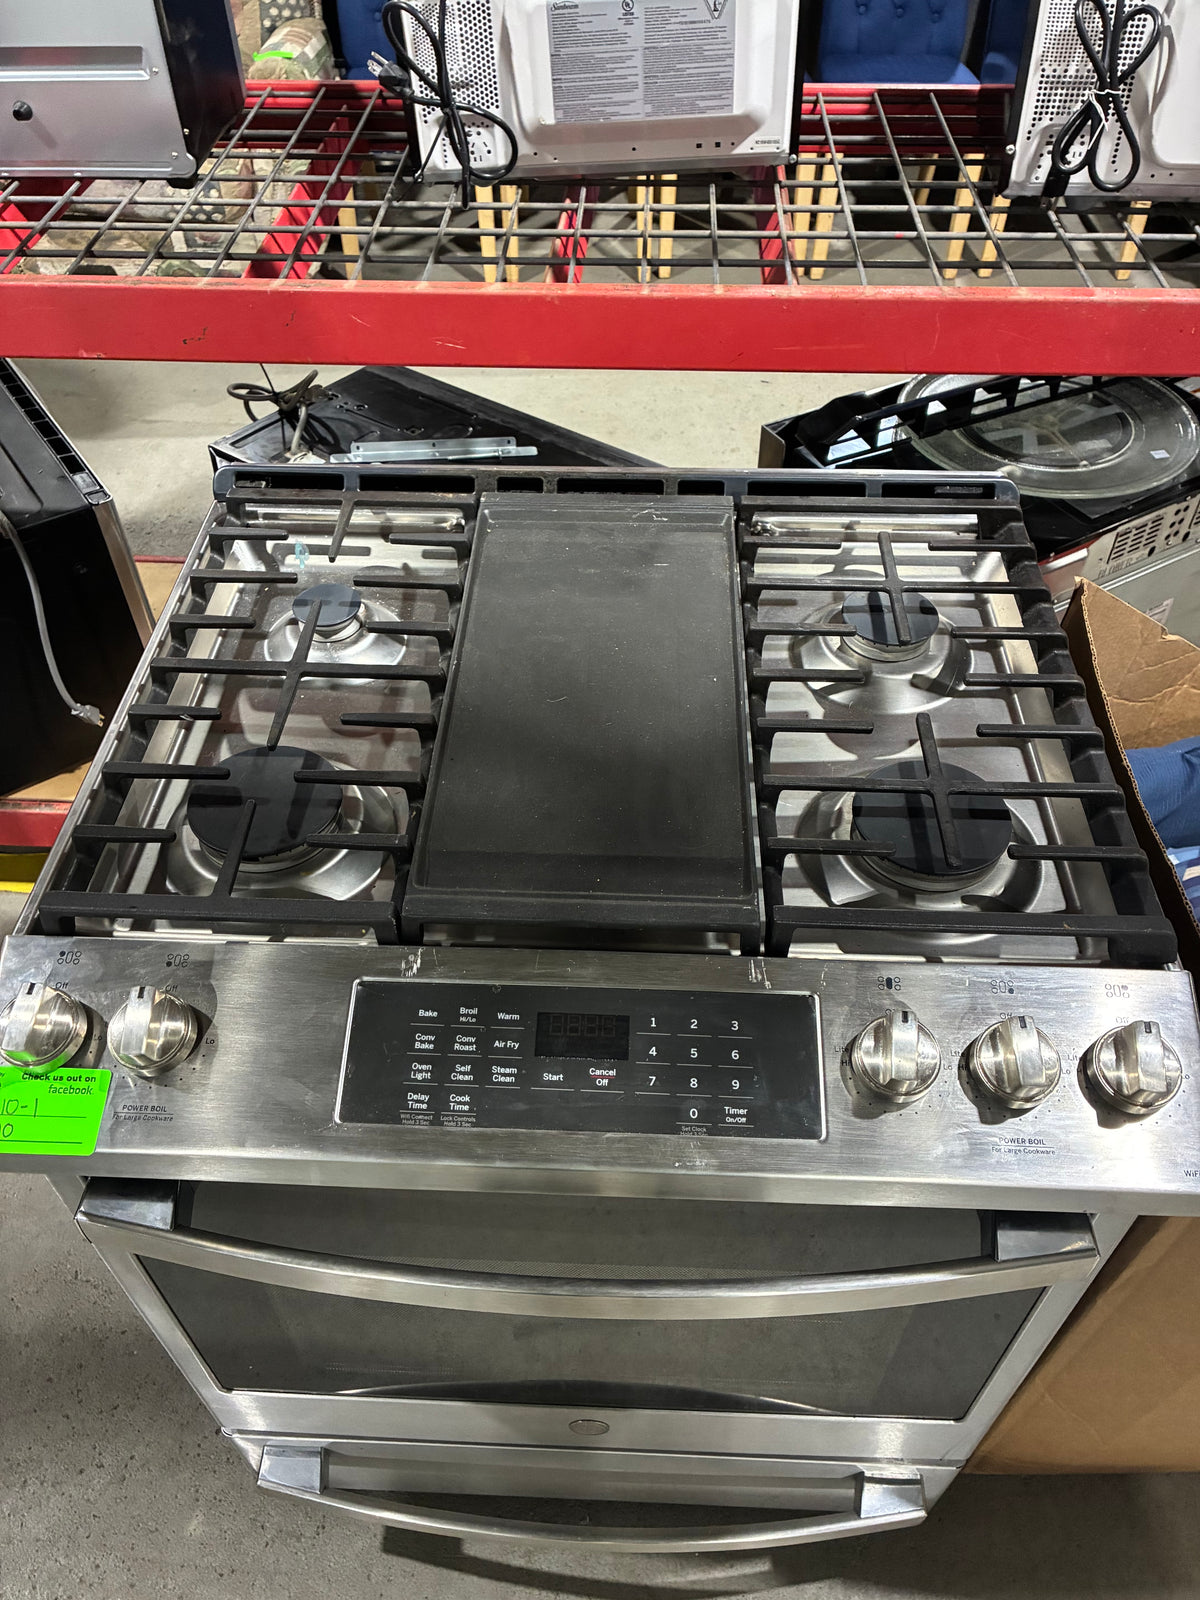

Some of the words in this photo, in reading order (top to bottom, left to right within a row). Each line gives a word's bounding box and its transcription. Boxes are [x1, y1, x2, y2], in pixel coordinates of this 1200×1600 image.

[551, 2, 579, 11] Sunbeam
[418, 1009, 438, 1018] Bake
[460, 1007, 478, 1015] Broil
[497, 1013, 520, 1021] Warm
[649, 1018, 657, 1028] 1
[690, 1019, 698, 1029] 2
[731, 1021, 739, 1031] 3
[415, 1033, 436, 1041] Conv
[456, 1035, 476, 1043] Conv
[414, 1042, 434, 1050] Bake
[454, 1043, 477, 1051] Roast
[493, 1041, 506, 1049] Air
[507, 1041, 520, 1050] Fry
[648, 1047, 657, 1057] 4
[690, 1048, 698, 1058] 5
[731, 1050, 740, 1060] 6
[412, 1063, 432, 1071] Oven
[455, 1064, 471, 1072] Self
[491, 1066, 517, 1074] Steam
[21, 1072, 50, 1081] Check
[411, 1071, 432, 1080] Light
[451, 1073, 474, 1081] Clean
[589, 1068, 616, 1077] Cancel
[492, 1074, 515, 1083] Clean
[543, 1073, 564, 1082] Start
[649, 1076, 657, 1086] 7
[596, 1078, 609, 1087] Off
[690, 1078, 698, 1088] 8
[731, 1080, 740, 1090] 9
[48, 1084, 93, 1095] facebook
[407, 1092, 430, 1102] Delay
[450, 1094, 471, 1102] Cook
[407, 1101, 428, 1110] Time
[449, 1103, 470, 1111] Time
[689, 1108, 698, 1119] 0
[724, 1106, 749, 1115] Timer
[998, 1137, 1026, 1145] POWER
